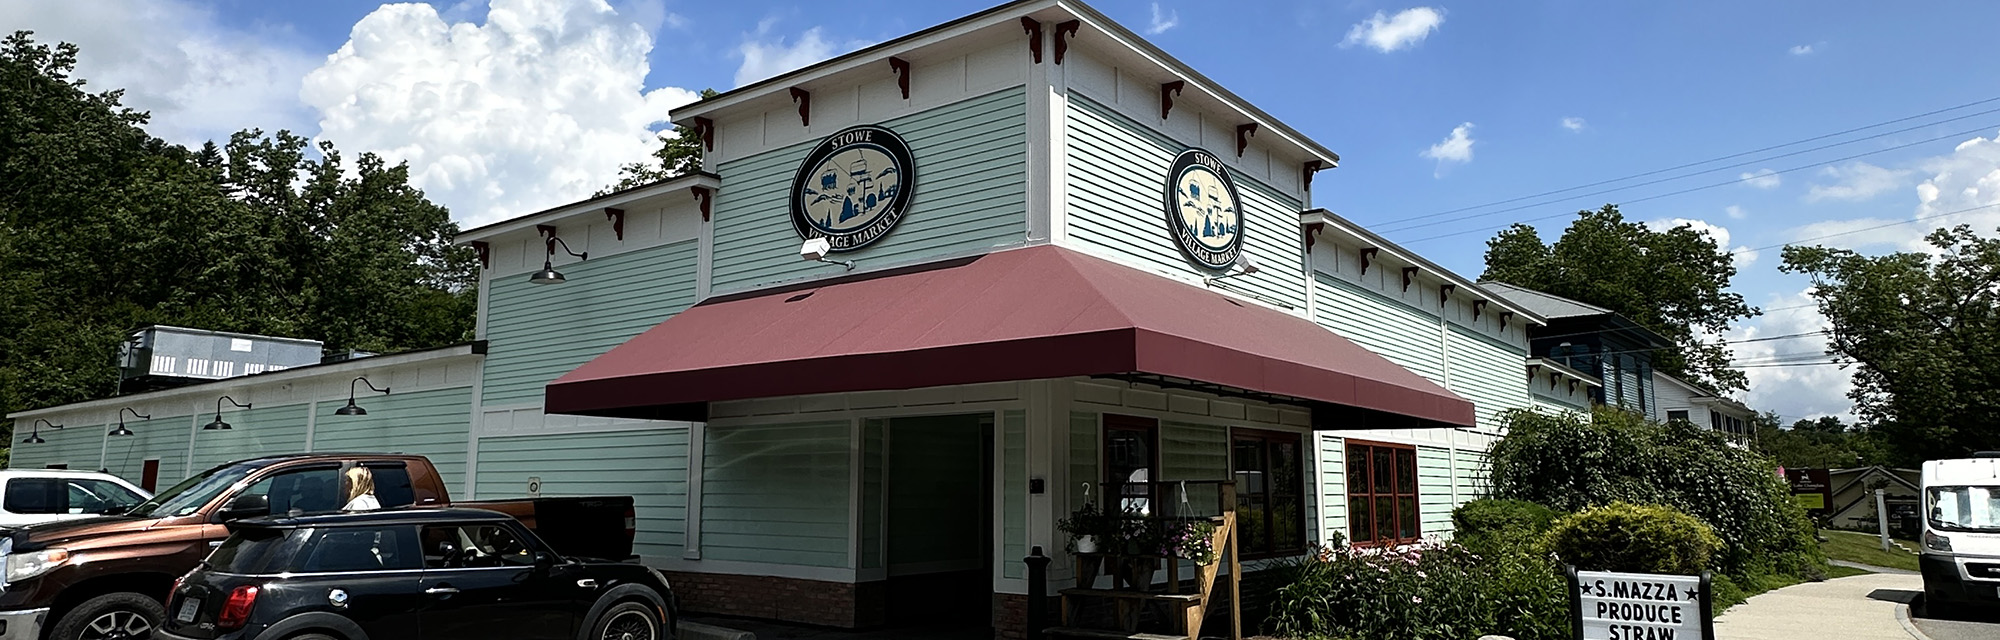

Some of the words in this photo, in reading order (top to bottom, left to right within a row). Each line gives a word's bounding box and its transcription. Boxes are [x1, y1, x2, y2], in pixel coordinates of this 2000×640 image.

[831, 130, 873, 150] STOWE
[1194, 152, 1222, 175] STOWE
[852, 207, 898, 246] MARKET
[1180, 228, 1210, 263] VILLAGE
[1210, 245, 1238, 264] MARKET
[1595, 580, 1678, 601] S.MAZZA
[1597, 601, 1682, 624] PRODUCE
[1609, 624, 1675, 640] STRAW
